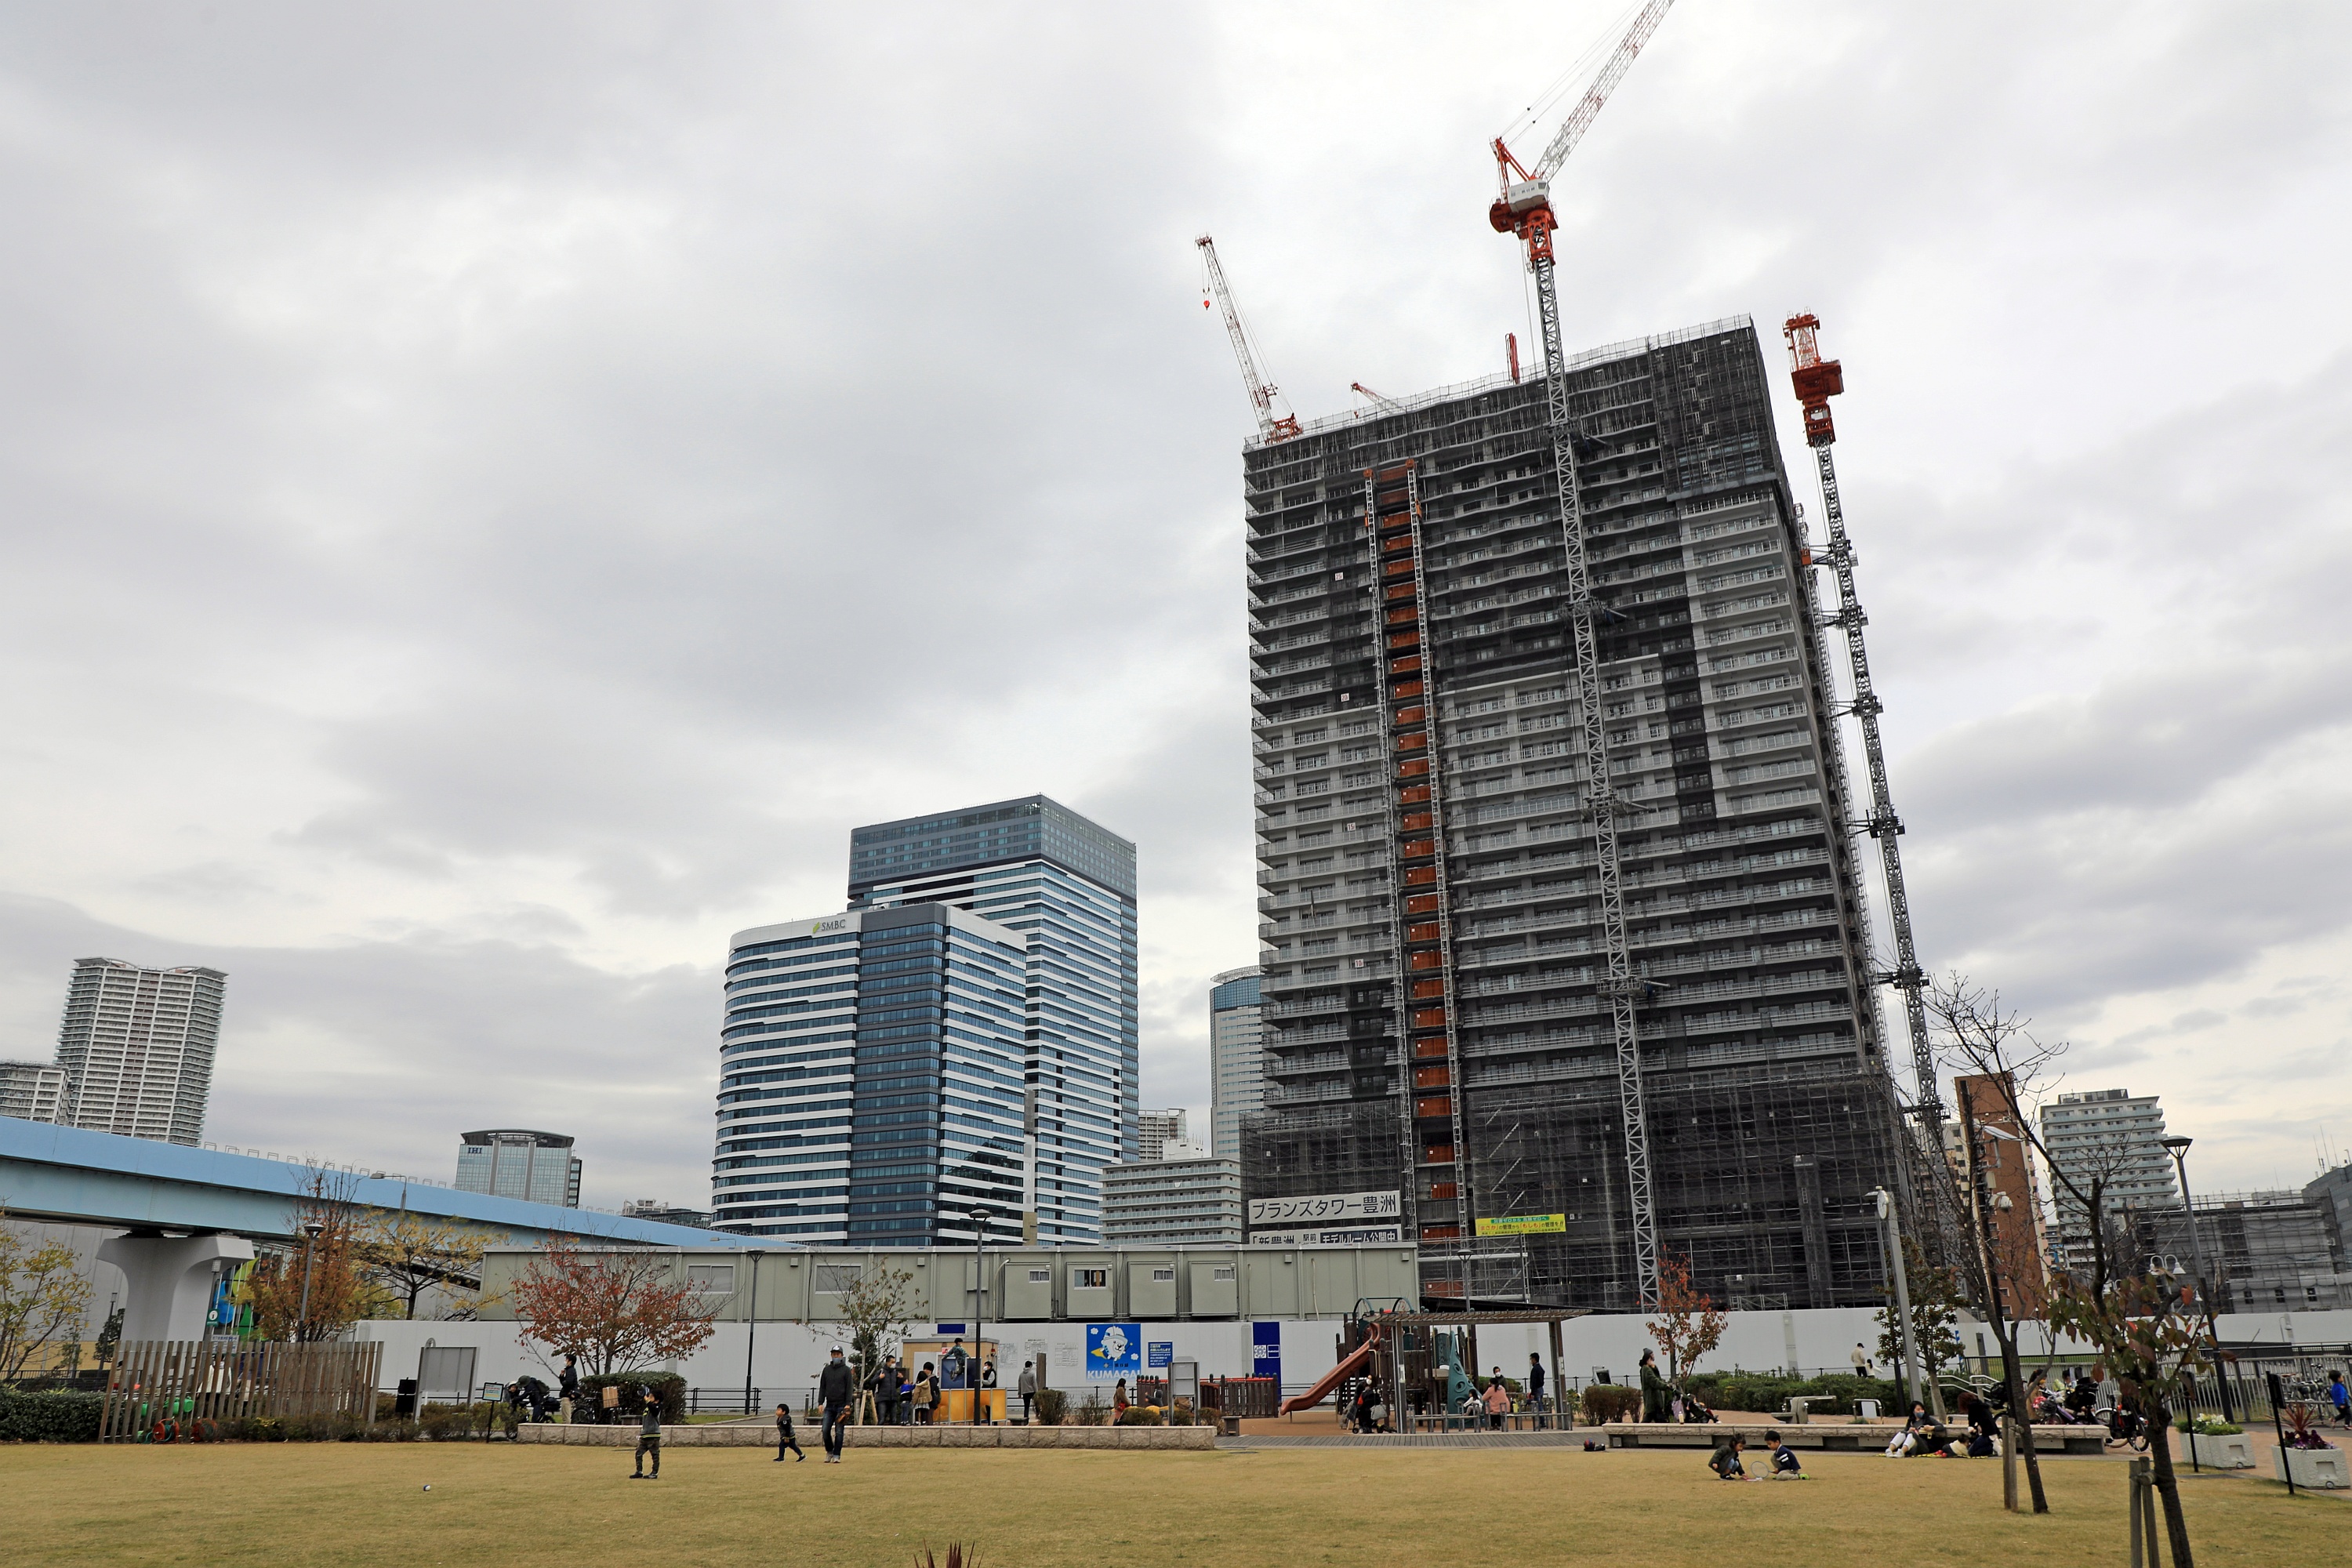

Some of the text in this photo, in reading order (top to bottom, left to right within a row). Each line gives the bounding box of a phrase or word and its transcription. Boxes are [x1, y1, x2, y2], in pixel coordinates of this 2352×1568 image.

[822, 920, 846, 931] SMBC
[1253, 1194, 1396, 1219] ブランズタワー豊洲
[1087, 1370, 1140, 1378] KUMAGAI
